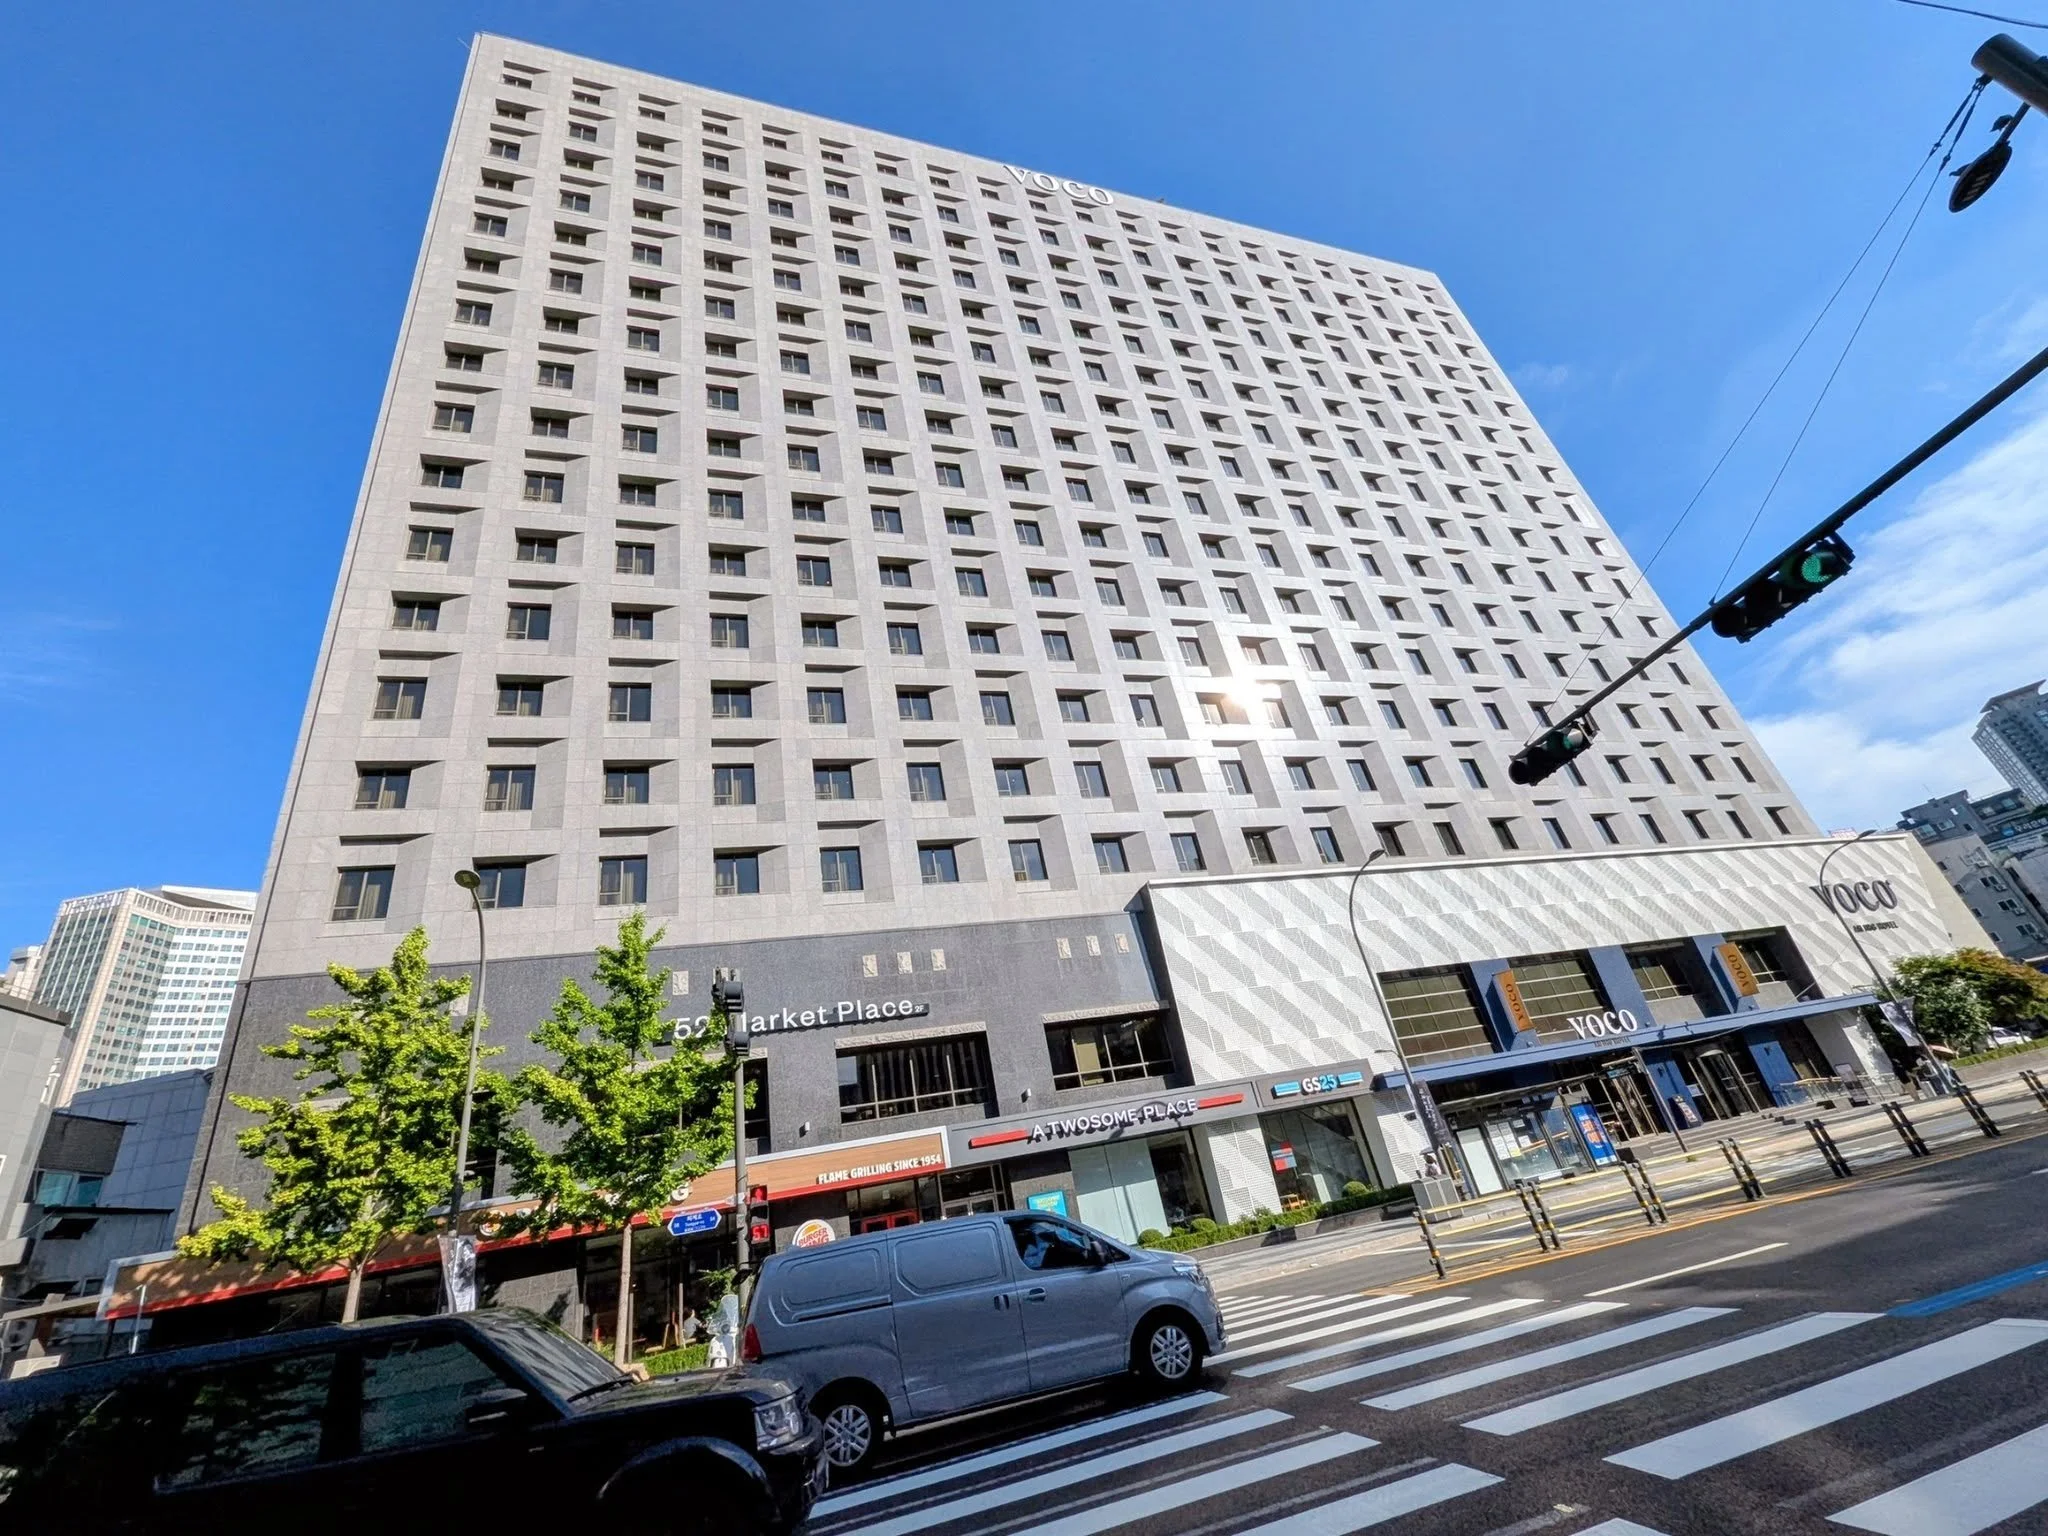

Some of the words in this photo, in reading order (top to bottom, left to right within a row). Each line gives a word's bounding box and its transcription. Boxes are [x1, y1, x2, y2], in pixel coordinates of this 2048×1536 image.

[837, 999, 914, 1022] Place
[915, 1004, 925, 1013] 2F
[1302, 1074, 1337, 1093] GS25
[1032, 1123, 1046, 1139] A
[1047, 1108, 1138, 1134] TWOSOME
[1143, 1098, 1199, 1119] PLACE
[818, 1169, 849, 1185] FLAME
[850, 1162, 893, 1179] GRILLING
[893, 1157, 920, 1172] SINCE
[920, 1153, 943, 1168] 1954
[799, 1227, 828, 1246] BURGER
